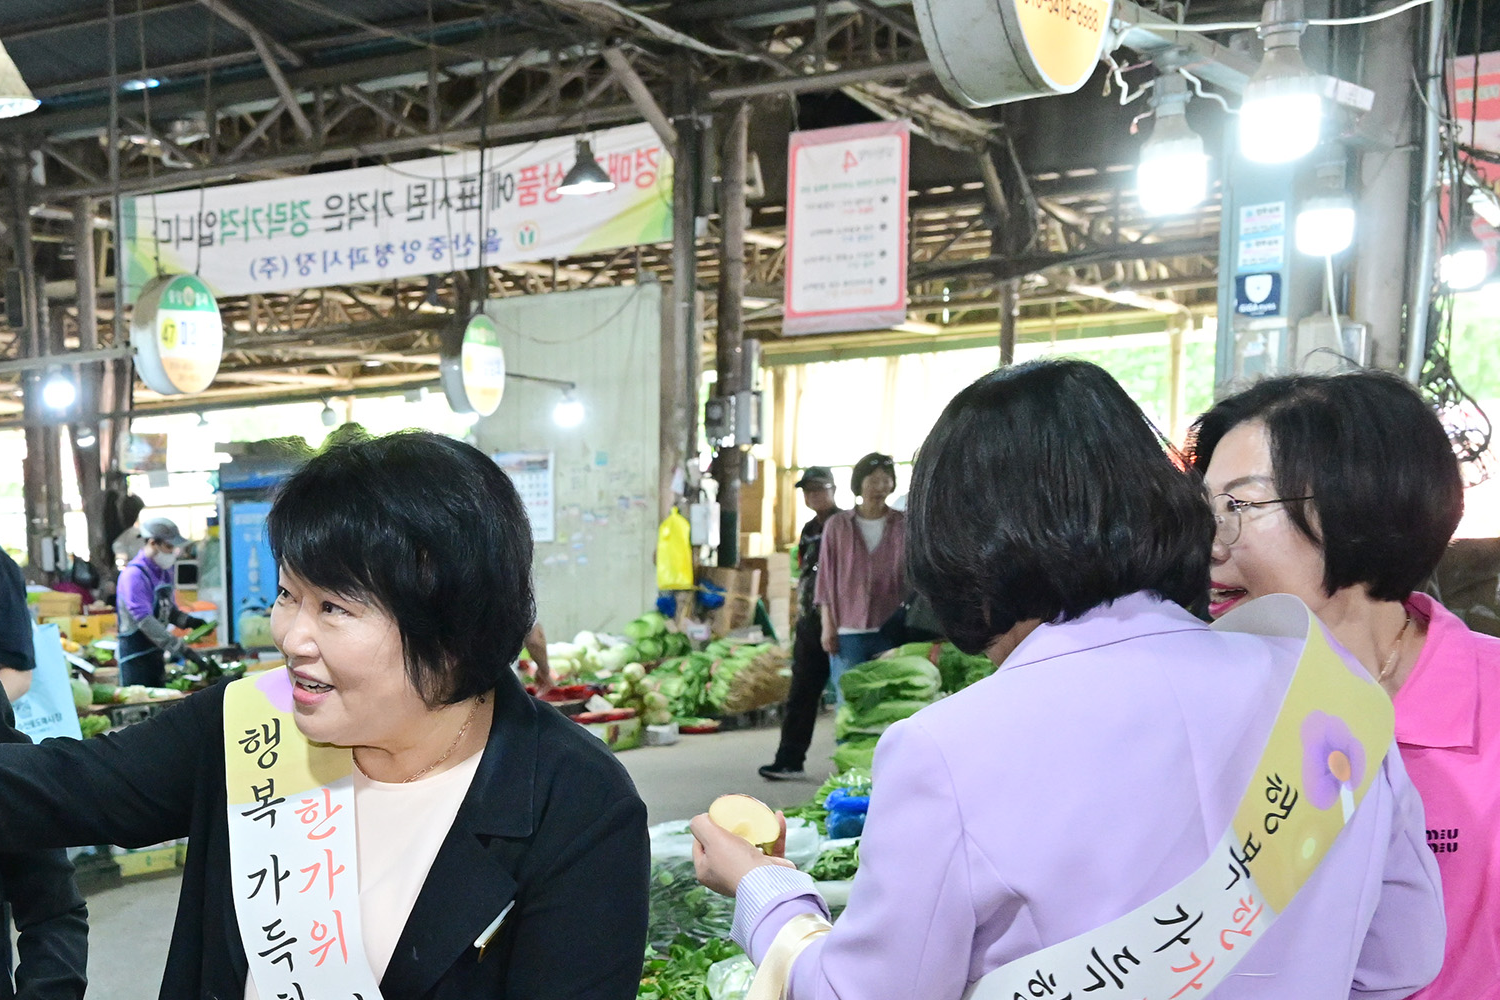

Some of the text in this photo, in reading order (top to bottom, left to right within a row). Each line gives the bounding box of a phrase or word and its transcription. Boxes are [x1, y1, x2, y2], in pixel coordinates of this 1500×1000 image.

[238, 716, 286, 829] 행복
[1224, 772, 1298, 891] 행복
[293, 787, 349, 968] 한가위
